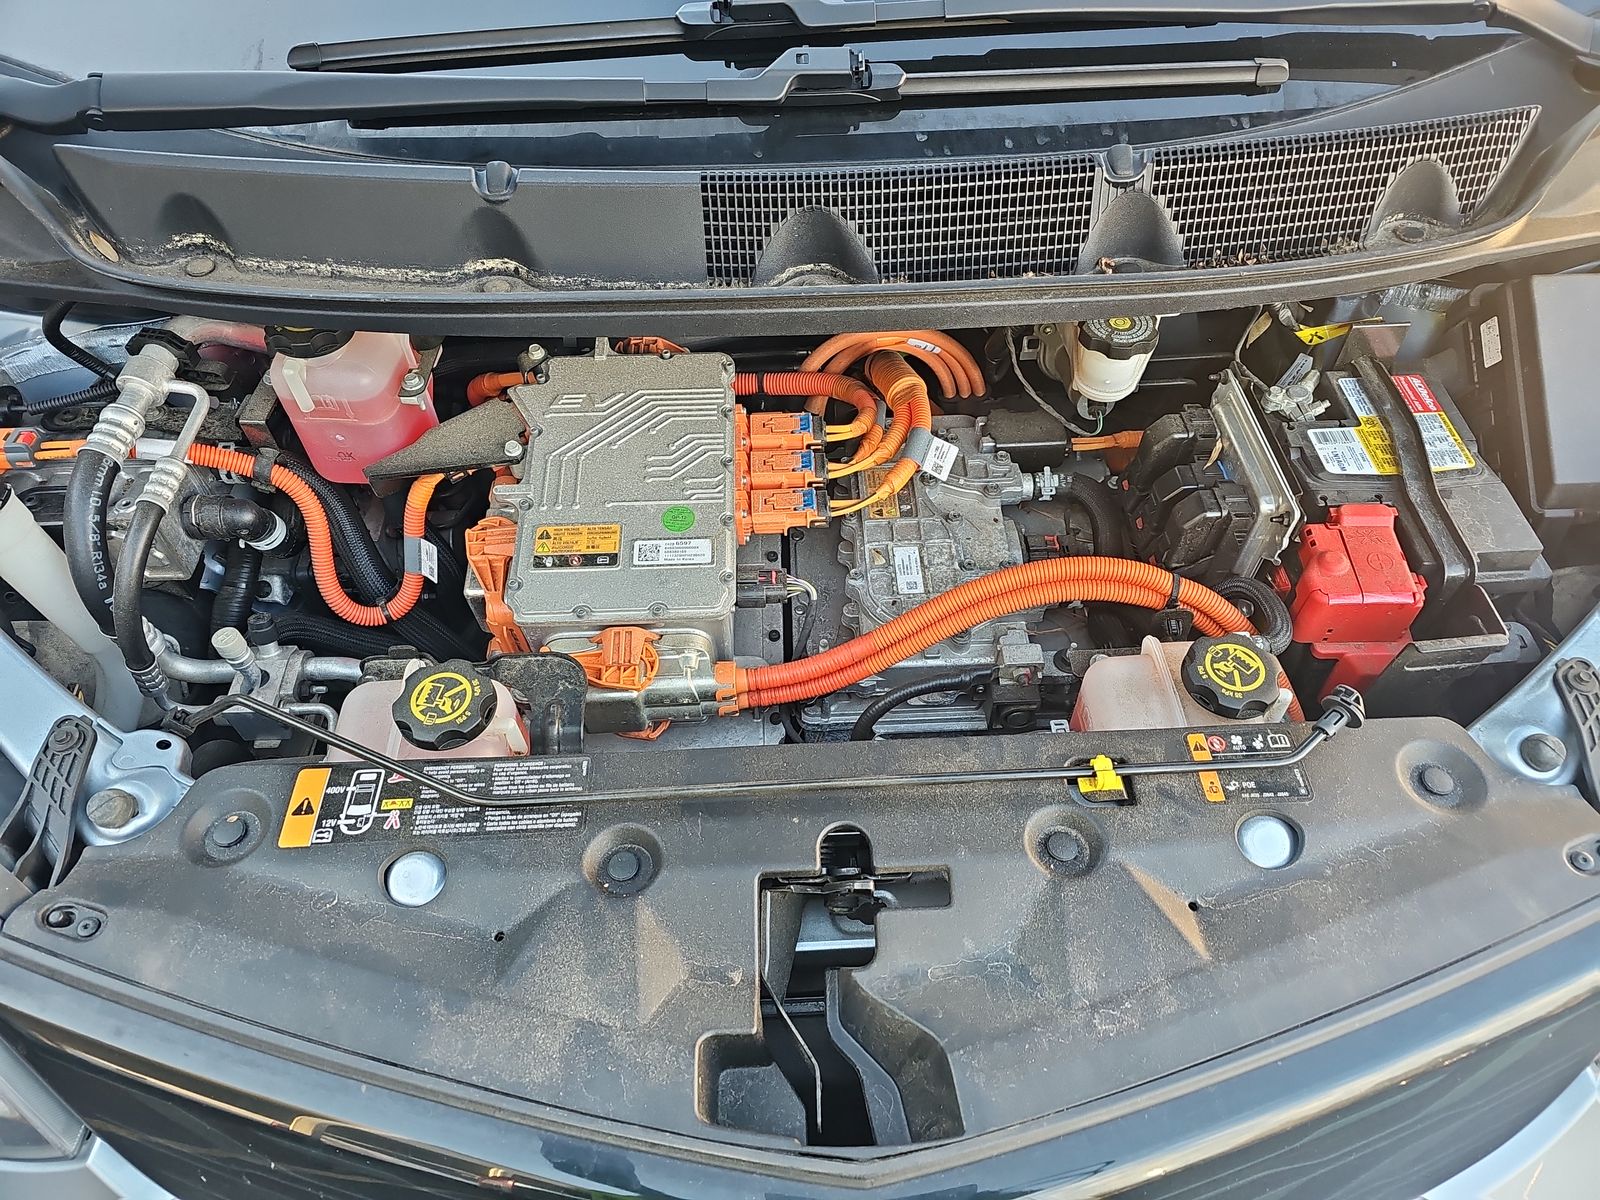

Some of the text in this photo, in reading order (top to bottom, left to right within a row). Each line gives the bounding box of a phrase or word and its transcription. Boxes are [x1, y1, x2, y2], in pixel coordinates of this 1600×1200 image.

[1410, 376, 1438, 411] ACDelco
[90, 551, 108, 591] R134a
[326, 786, 347, 795] 400V
[321, 818, 337, 828] 12V
